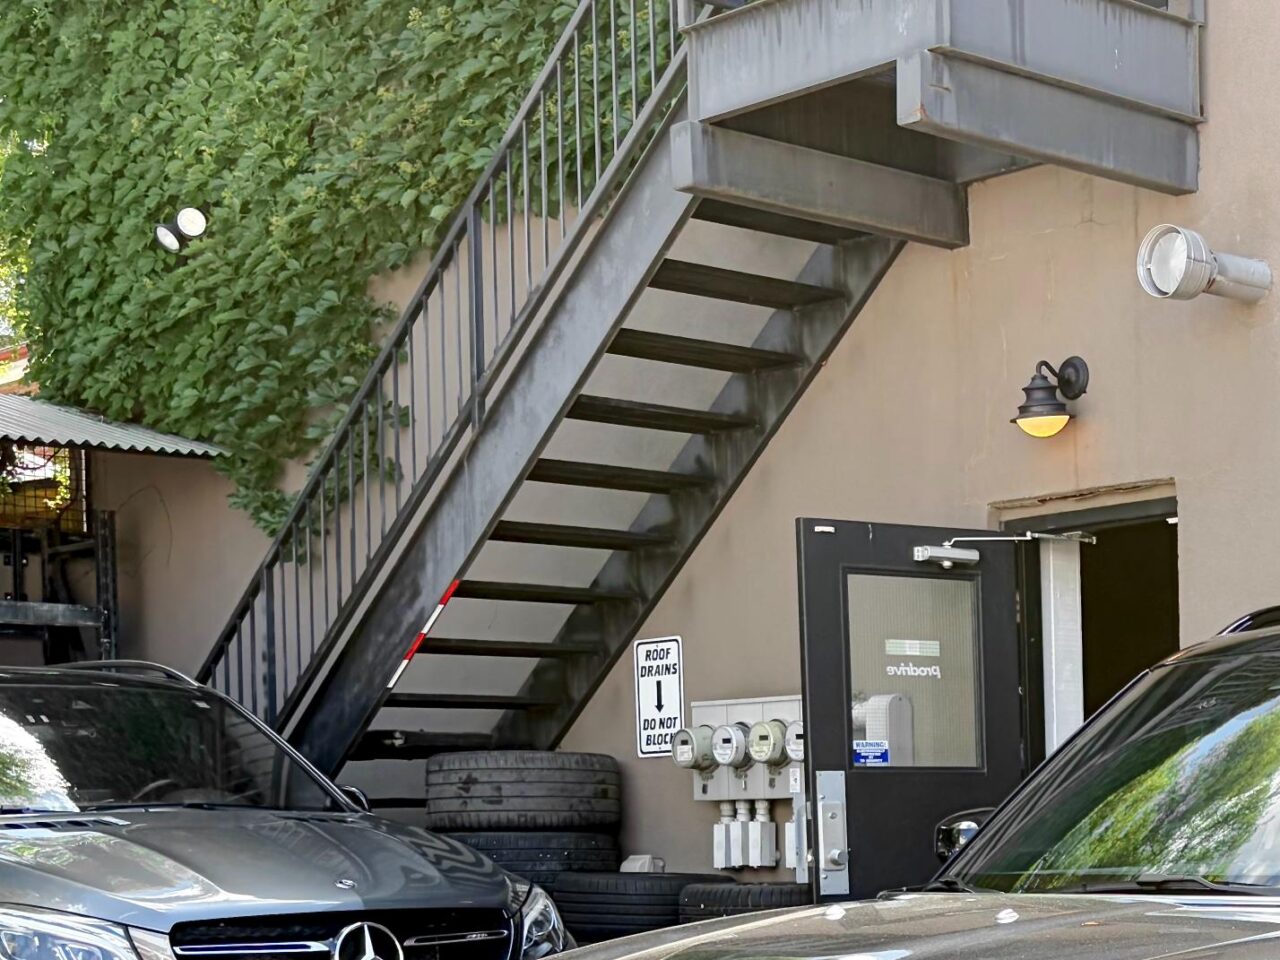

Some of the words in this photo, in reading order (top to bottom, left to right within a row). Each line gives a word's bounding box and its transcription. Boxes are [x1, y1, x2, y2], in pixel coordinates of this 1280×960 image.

[645, 648, 671, 662] ROOF
[640, 663, 678, 678] DRAINS
[643, 718, 656, 731] DO
[658, 717, 678, 730] NOT
